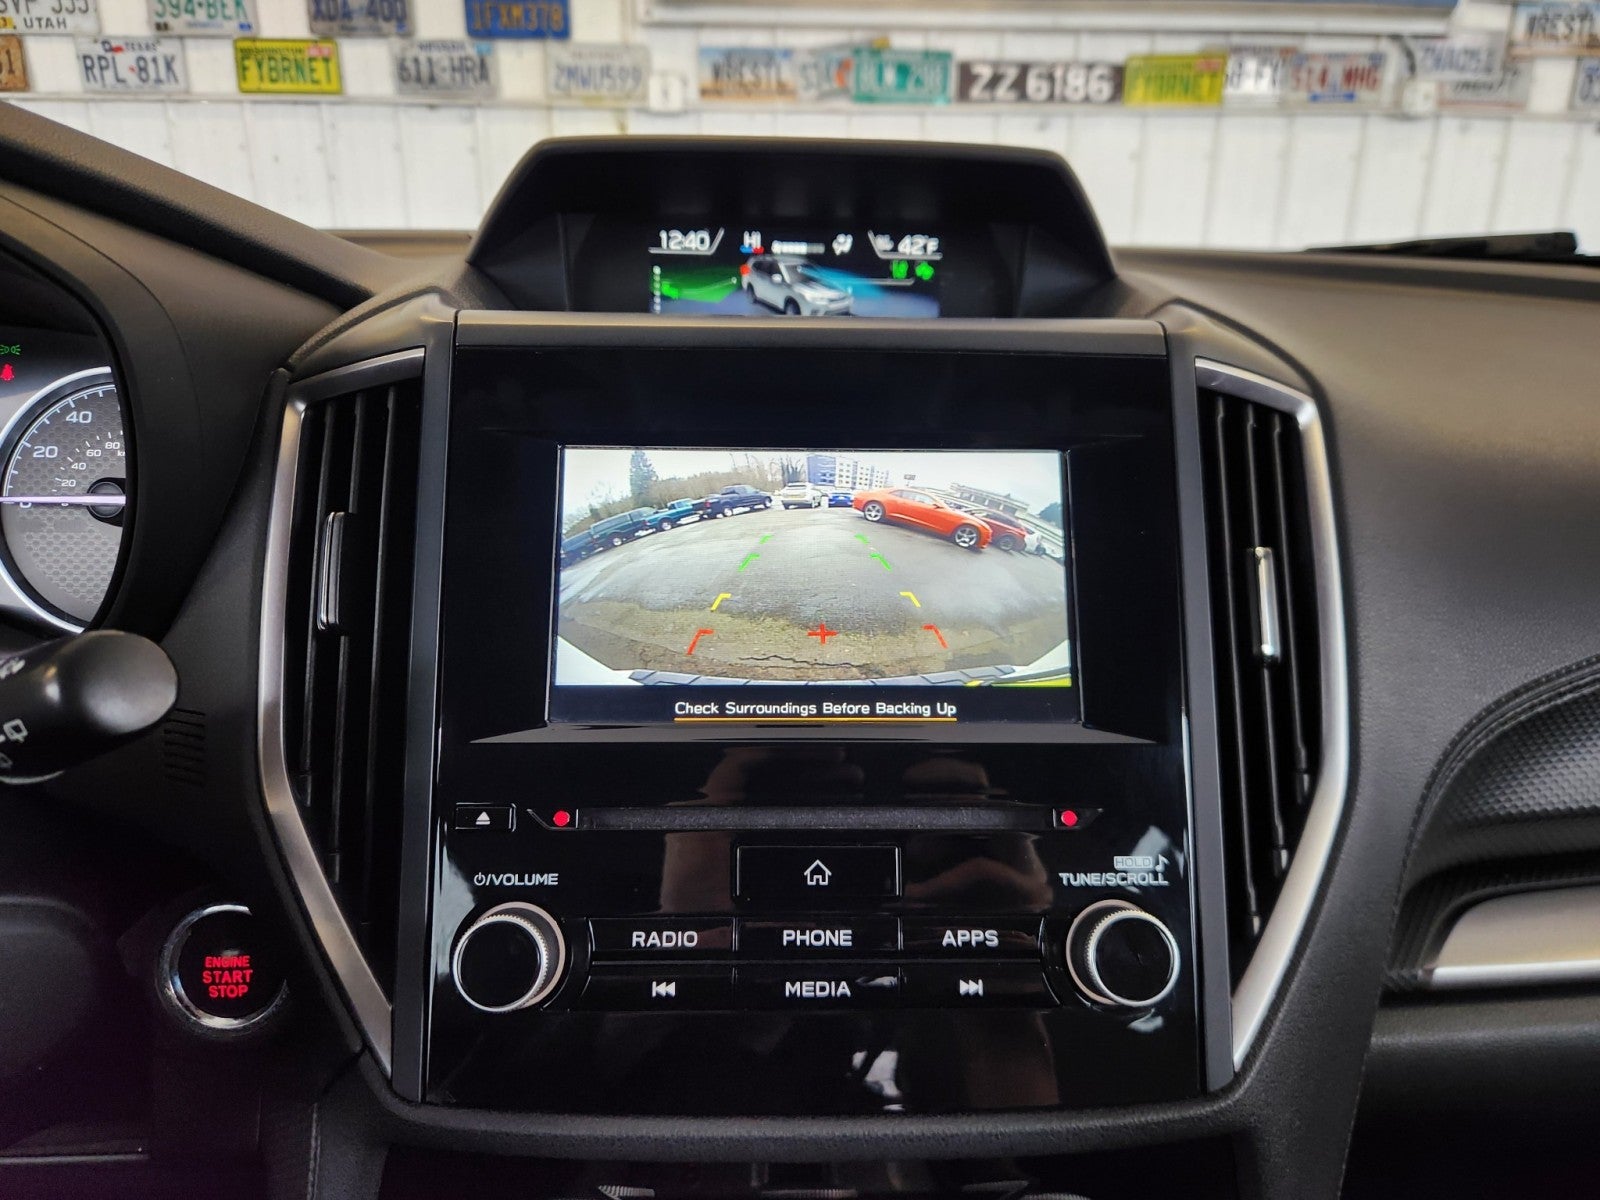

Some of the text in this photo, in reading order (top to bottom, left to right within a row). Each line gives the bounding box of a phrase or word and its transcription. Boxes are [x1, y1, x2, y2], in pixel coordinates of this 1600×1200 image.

[23, 16, 68, 29] UTAH
[240, 57, 333, 85] FYBRNET
[969, 62, 1020, 100] ZZ
[1025, 63, 1115, 103] 6186
[65, 411, 92, 424] 40
[33, 445, 59, 458] 20
[105, 441, 120, 450] 80
[86, 449, 102, 457] 60
[71, 462, 87, 470] 40
[61, 479, 77, 487] 20
[674, 702, 958, 717] Check Surroundings Before Backing Up
[1114, 857, 1152, 867] HOLD
[1058, 872, 1169, 887] TUNE/SCROLL
[631, 931, 699, 948] RADIO
[782, 930, 853, 947] PHONE
[941, 930, 1000, 947] APPS
[204, 955, 251, 968] ENGINE
[202, 969, 254, 984] START
[208, 984, 249, 998] STOP
[784, 981, 851, 998] MEDIA
